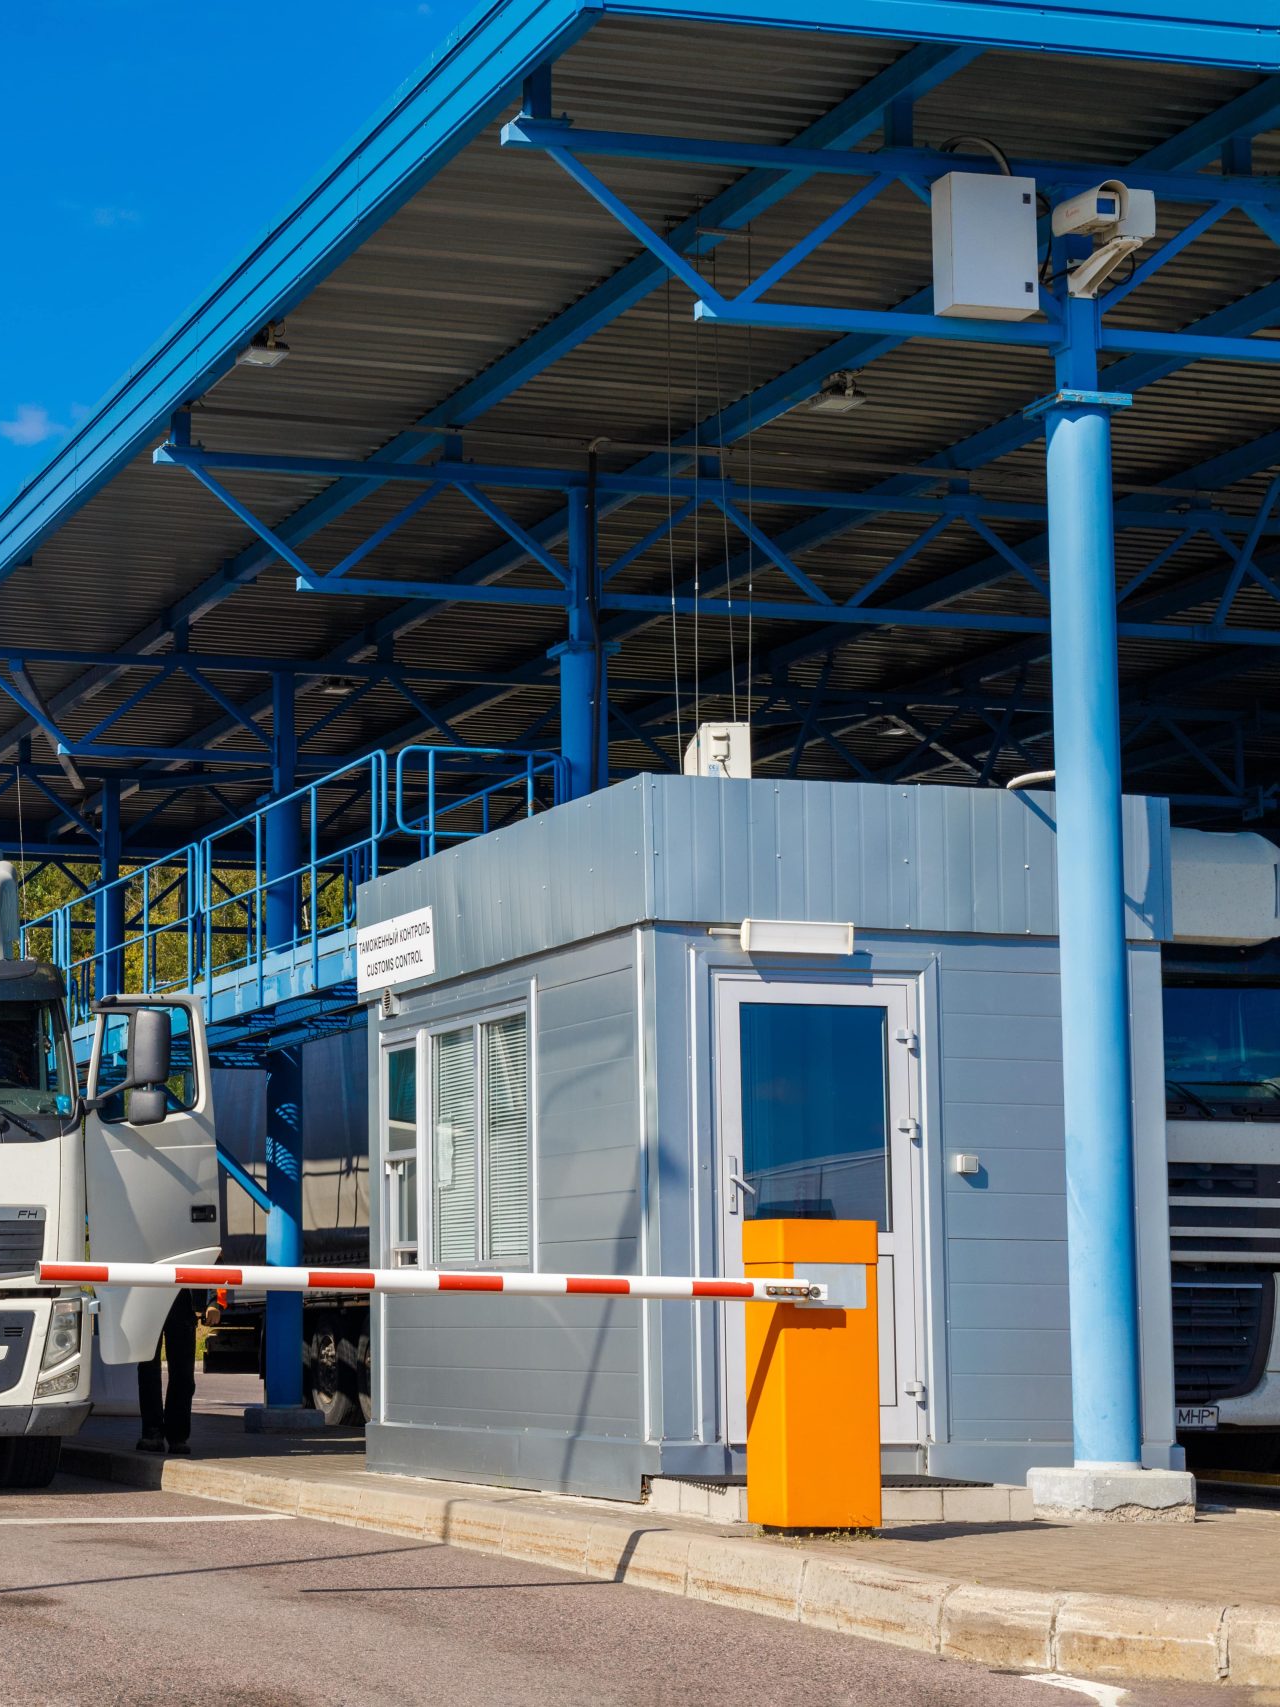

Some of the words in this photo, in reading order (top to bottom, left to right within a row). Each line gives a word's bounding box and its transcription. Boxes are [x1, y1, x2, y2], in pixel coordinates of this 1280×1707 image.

[359, 928, 398, 955] ТАМОЖЕННЫЙ
[400, 921, 430, 942] КОНТРОЛЬ
[366, 957, 394, 977] CUSTOMS
[395, 949, 423, 969] CONTROL
[17, 1210, 37, 1219] FH
[1178, 1409, 1211, 1424] MHP
